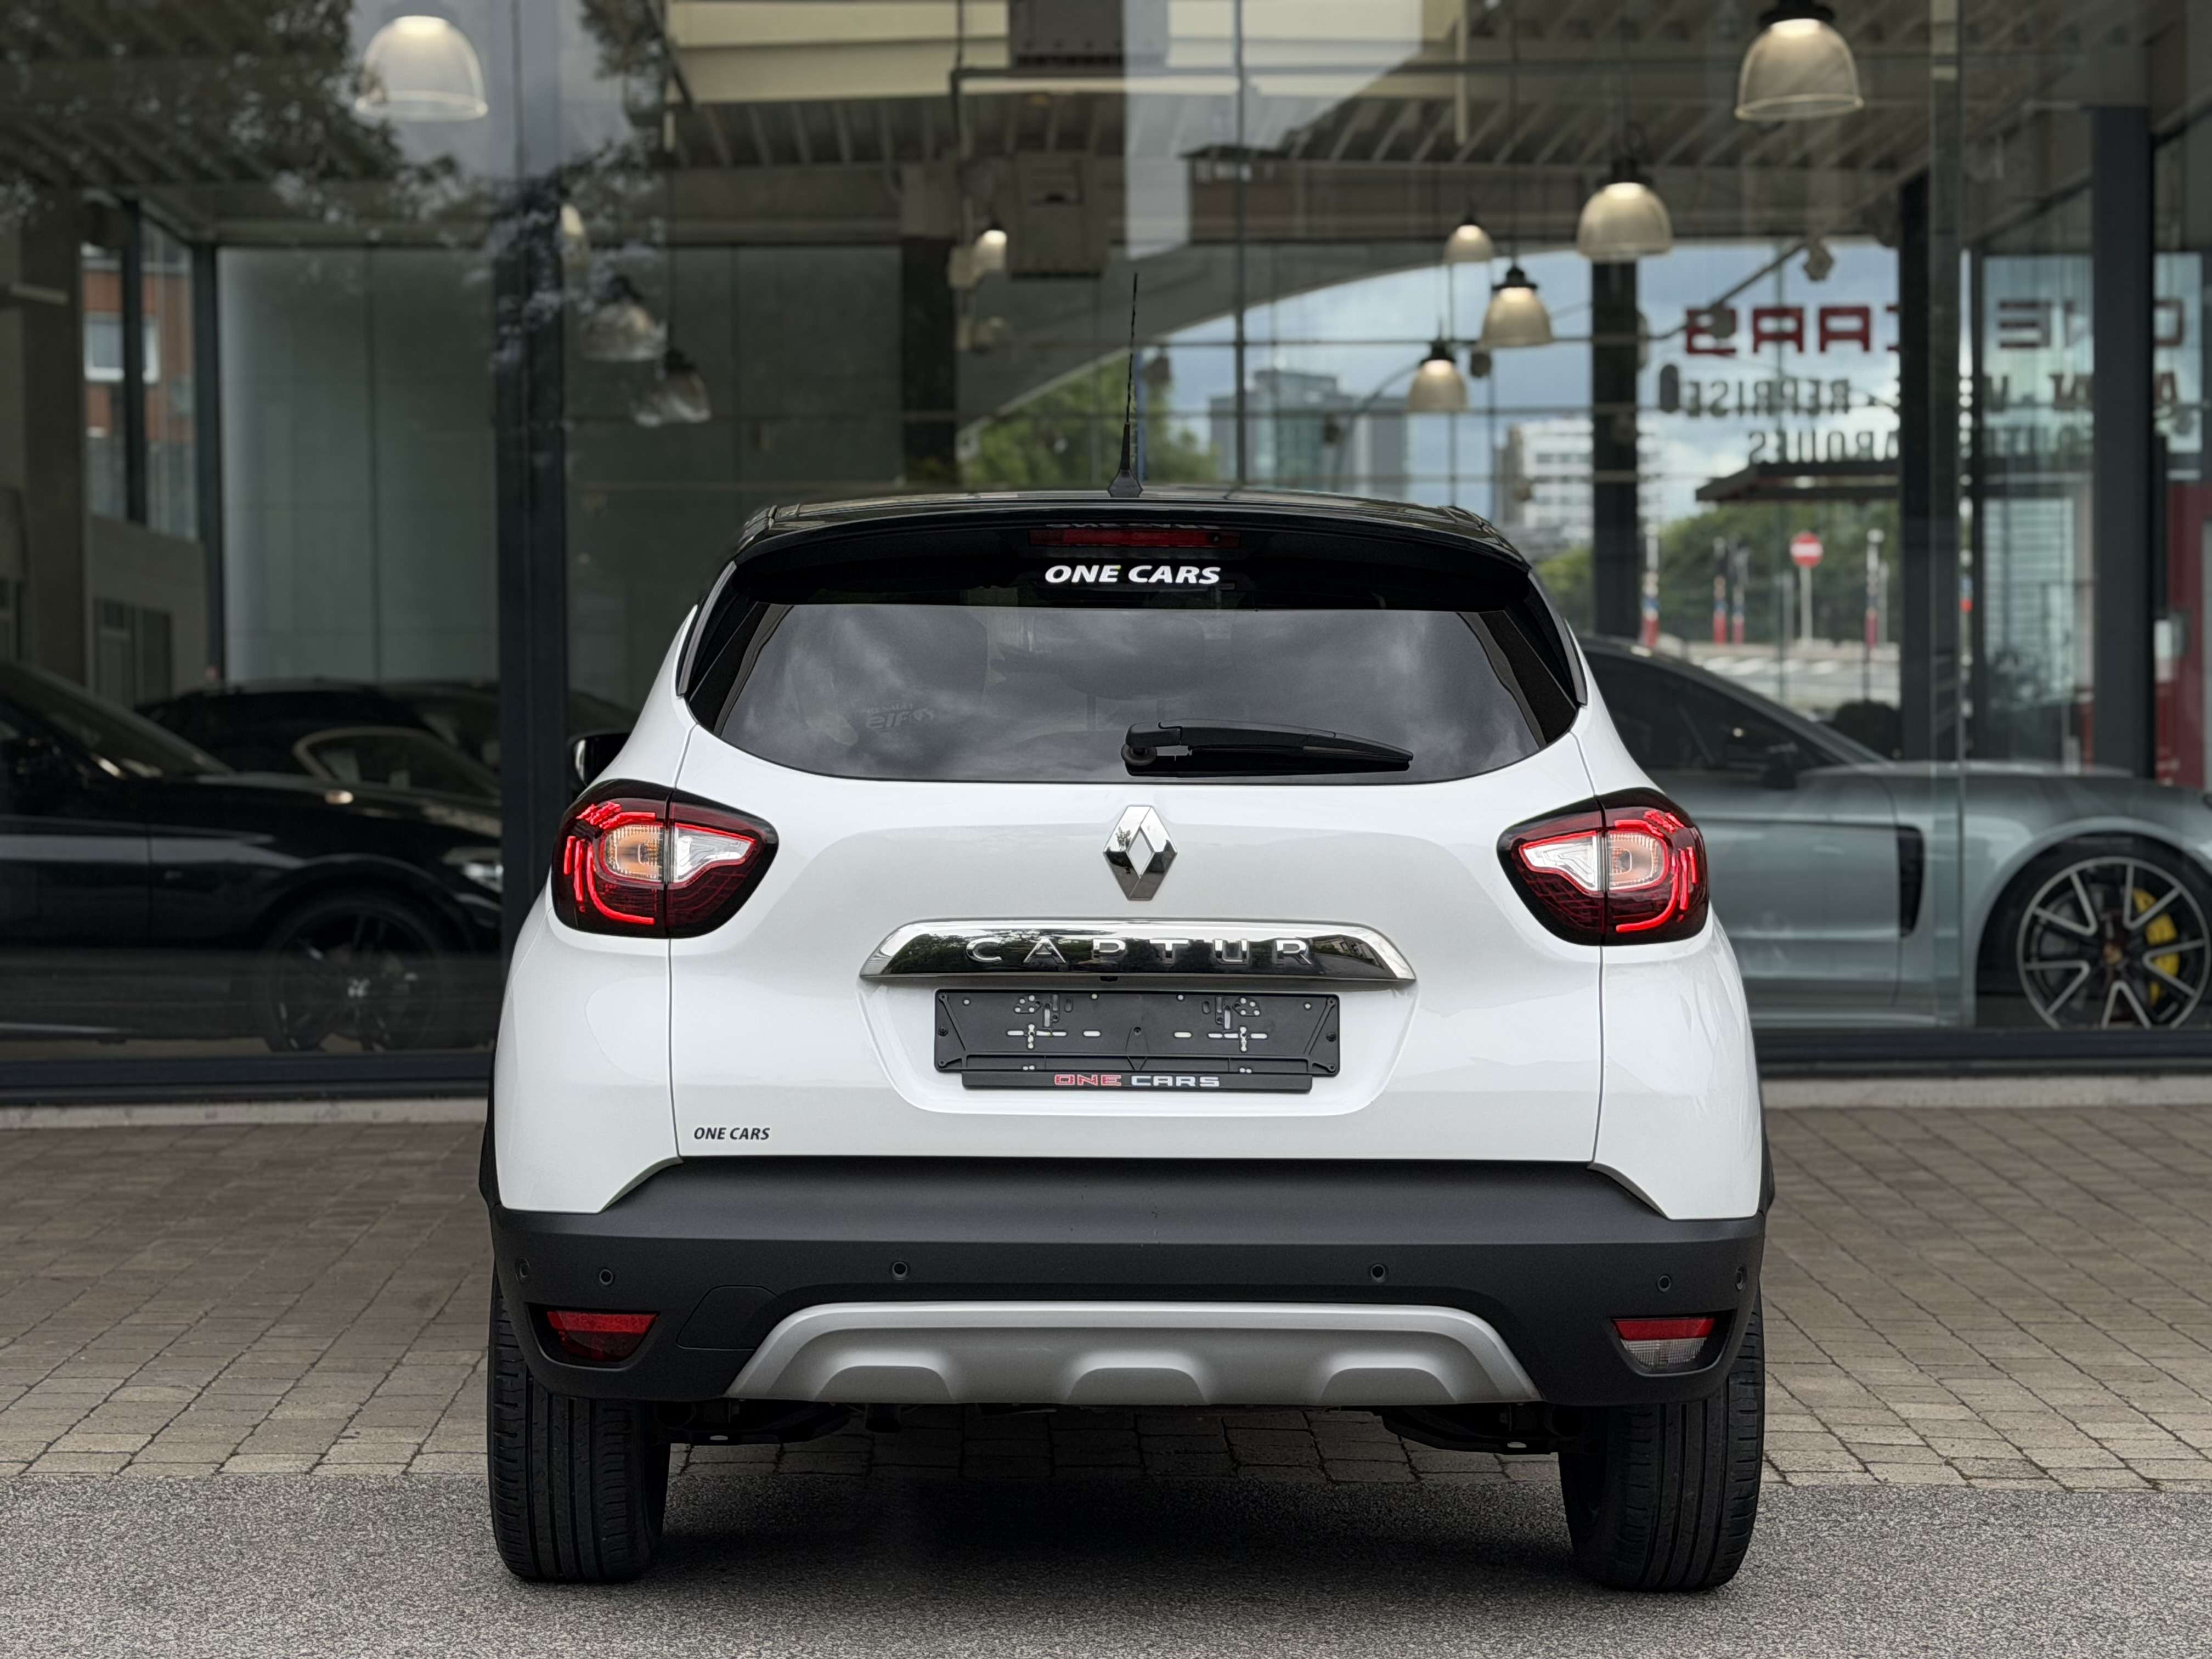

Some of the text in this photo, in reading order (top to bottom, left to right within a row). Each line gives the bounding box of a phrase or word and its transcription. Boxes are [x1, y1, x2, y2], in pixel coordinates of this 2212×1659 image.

[1045, 565, 1221, 584] ONE CARS
[965, 937, 1313, 966] CAPTUR
[1054, 1074, 1220, 1087] ONE CARS
[693, 1127, 771, 1141] ONE CARS
